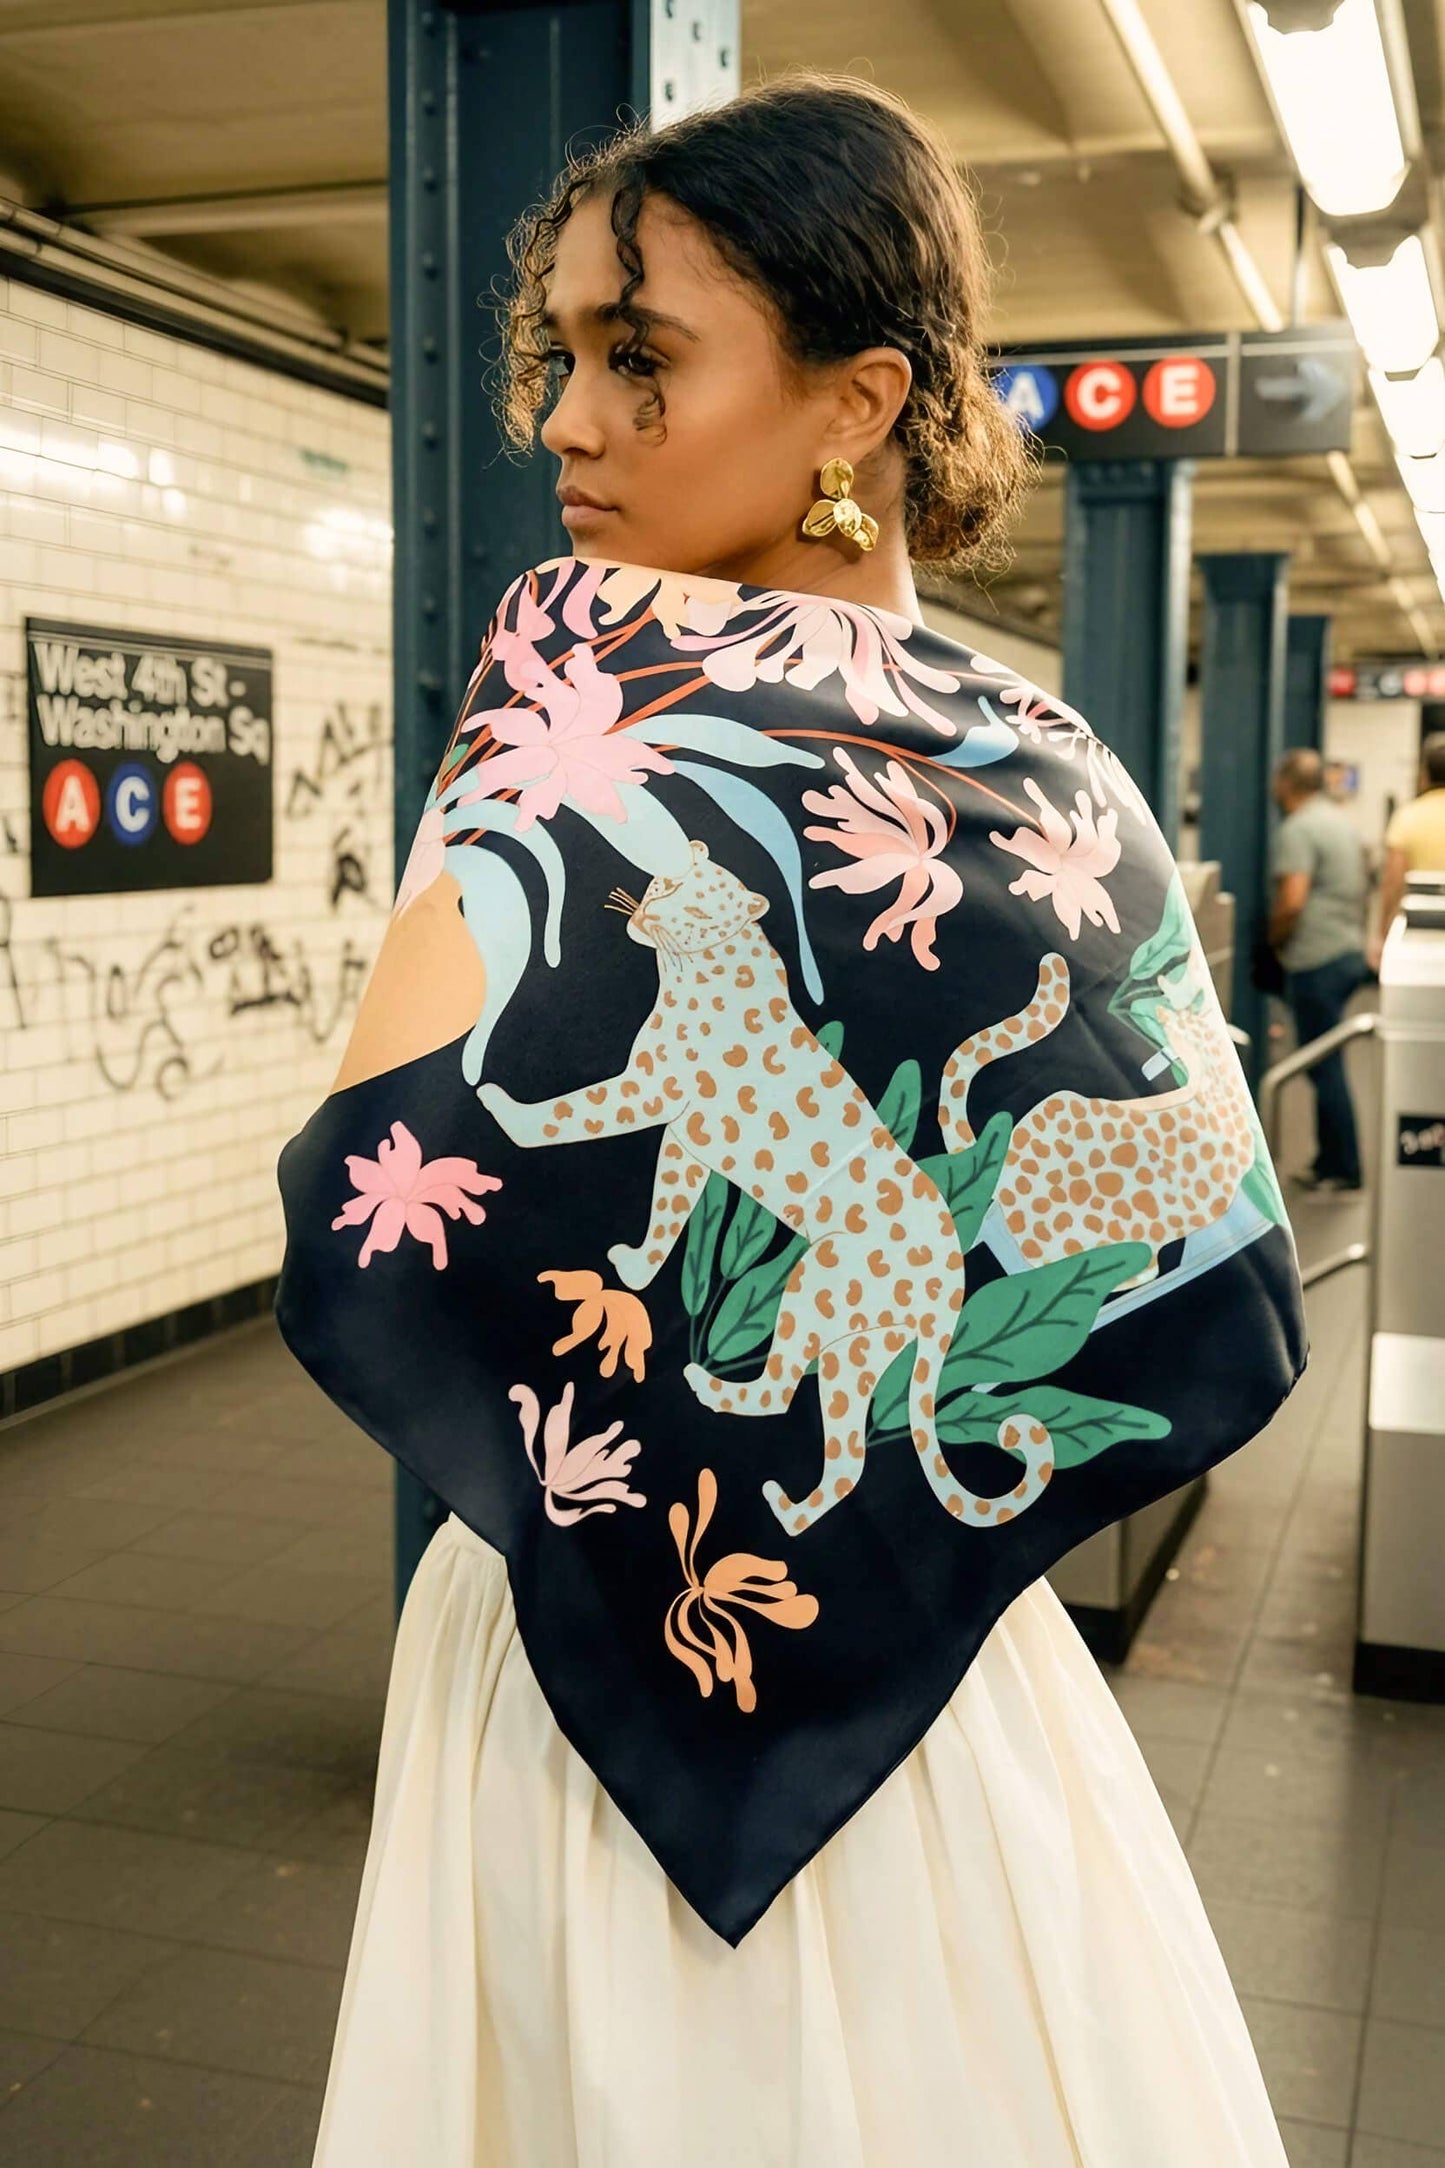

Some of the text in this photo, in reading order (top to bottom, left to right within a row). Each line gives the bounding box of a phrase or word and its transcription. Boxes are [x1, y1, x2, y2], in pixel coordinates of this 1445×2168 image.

[1006, 364, 1198, 420] A C E
[34, 641, 128, 700] West
[131, 653, 188, 704] 4th
[36, 694, 227, 763] Washington
[228, 705, 270, 766] Sq
[55, 774, 202, 832] A C E
